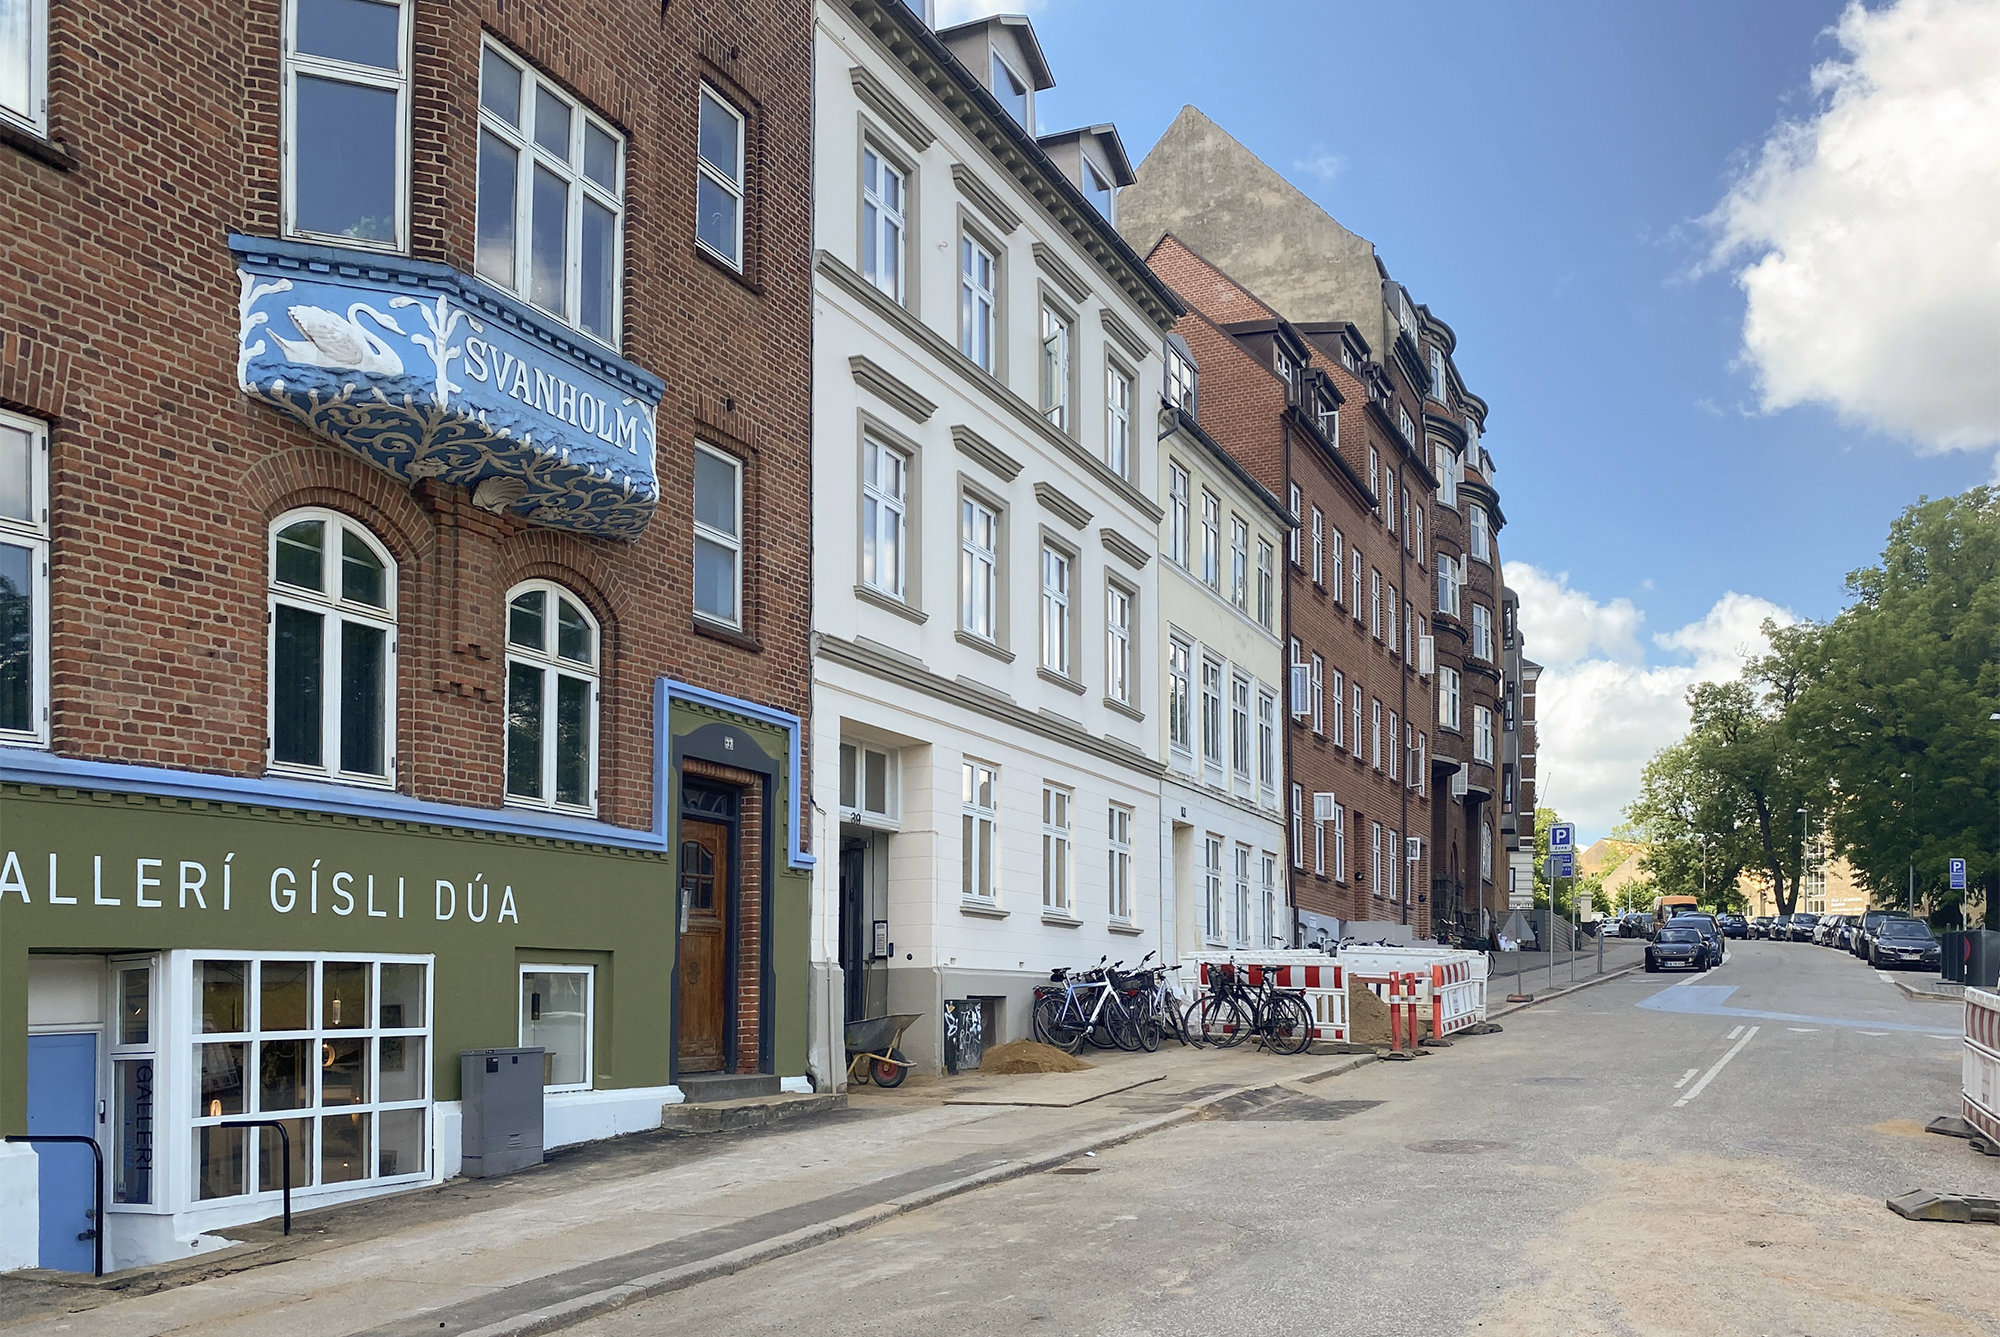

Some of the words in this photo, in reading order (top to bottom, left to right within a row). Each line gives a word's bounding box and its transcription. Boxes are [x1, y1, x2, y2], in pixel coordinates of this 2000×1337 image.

[464, 336, 638, 456] SVANHOLM
[1556, 830, 1567, 844] P
[270, 858, 405, 919] GÍSLI
[435, 873, 519, 924] DÚA
